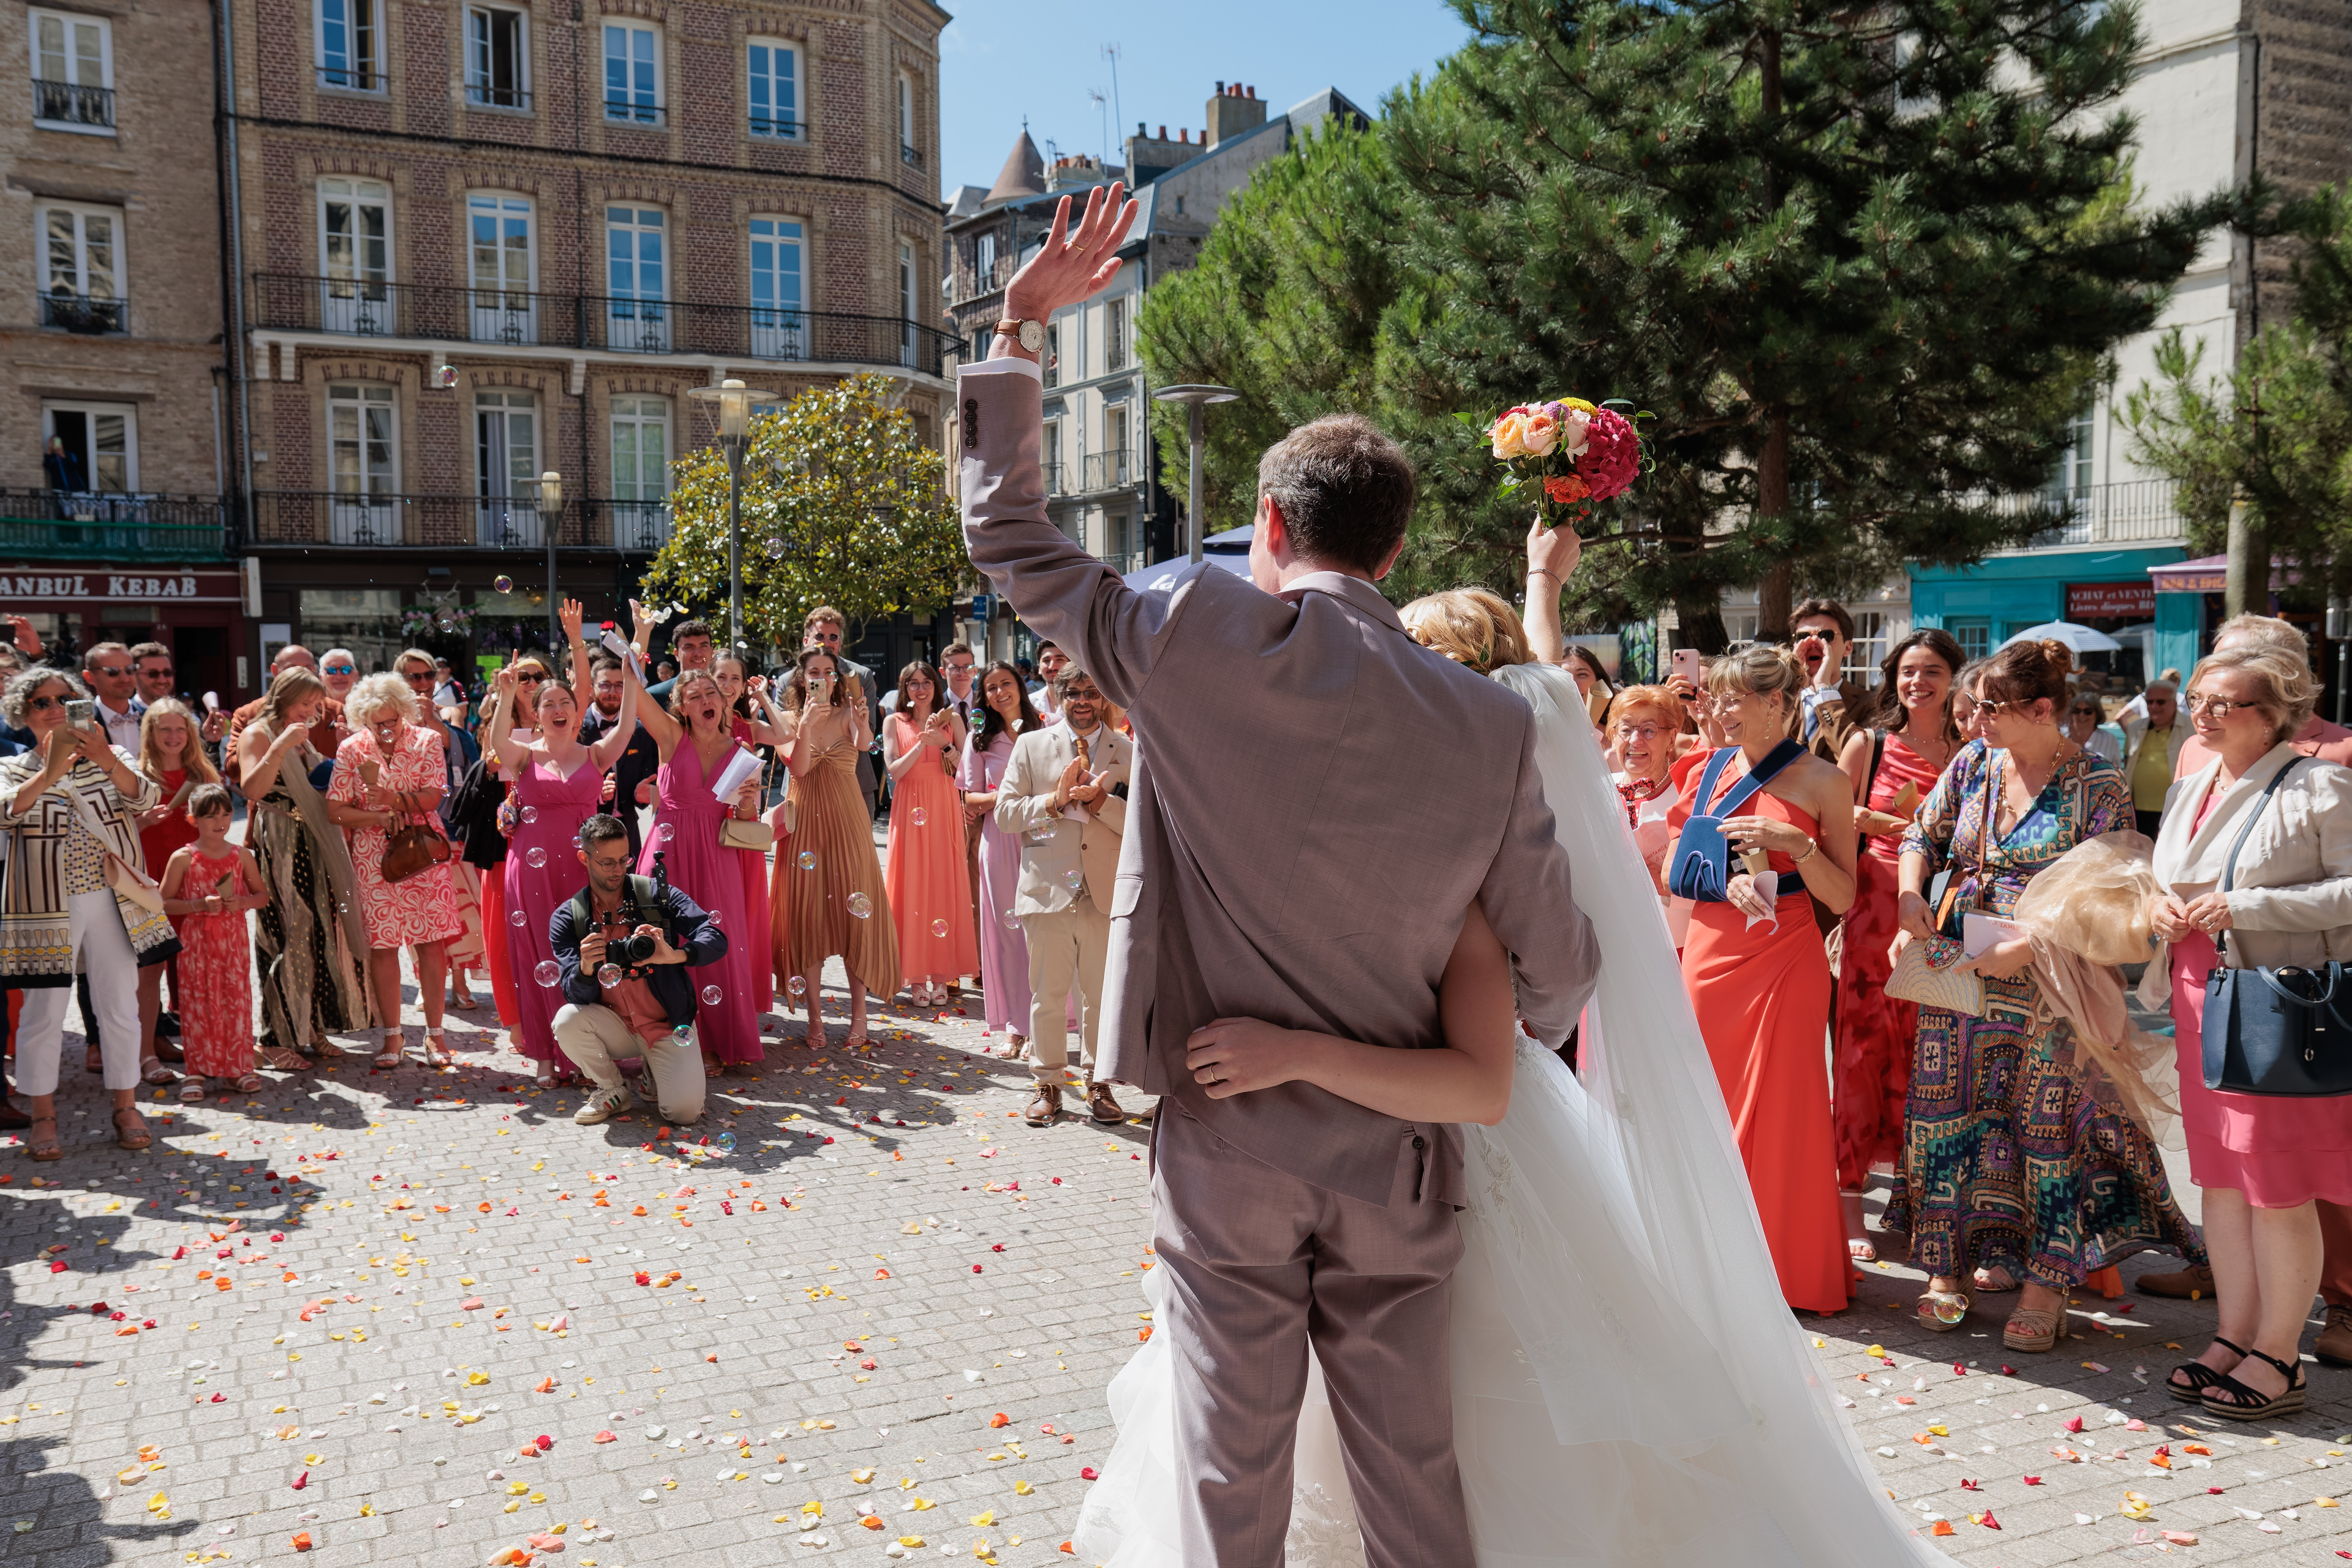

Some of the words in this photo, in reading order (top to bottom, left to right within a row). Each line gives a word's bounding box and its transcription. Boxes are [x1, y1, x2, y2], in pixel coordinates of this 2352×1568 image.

[107, 576, 197, 596] KEBAB
[2070, 590, 2105, 601] ACHAT
[2070, 602, 2097, 612] Livres
[2100, 601, 2136, 613] disques
